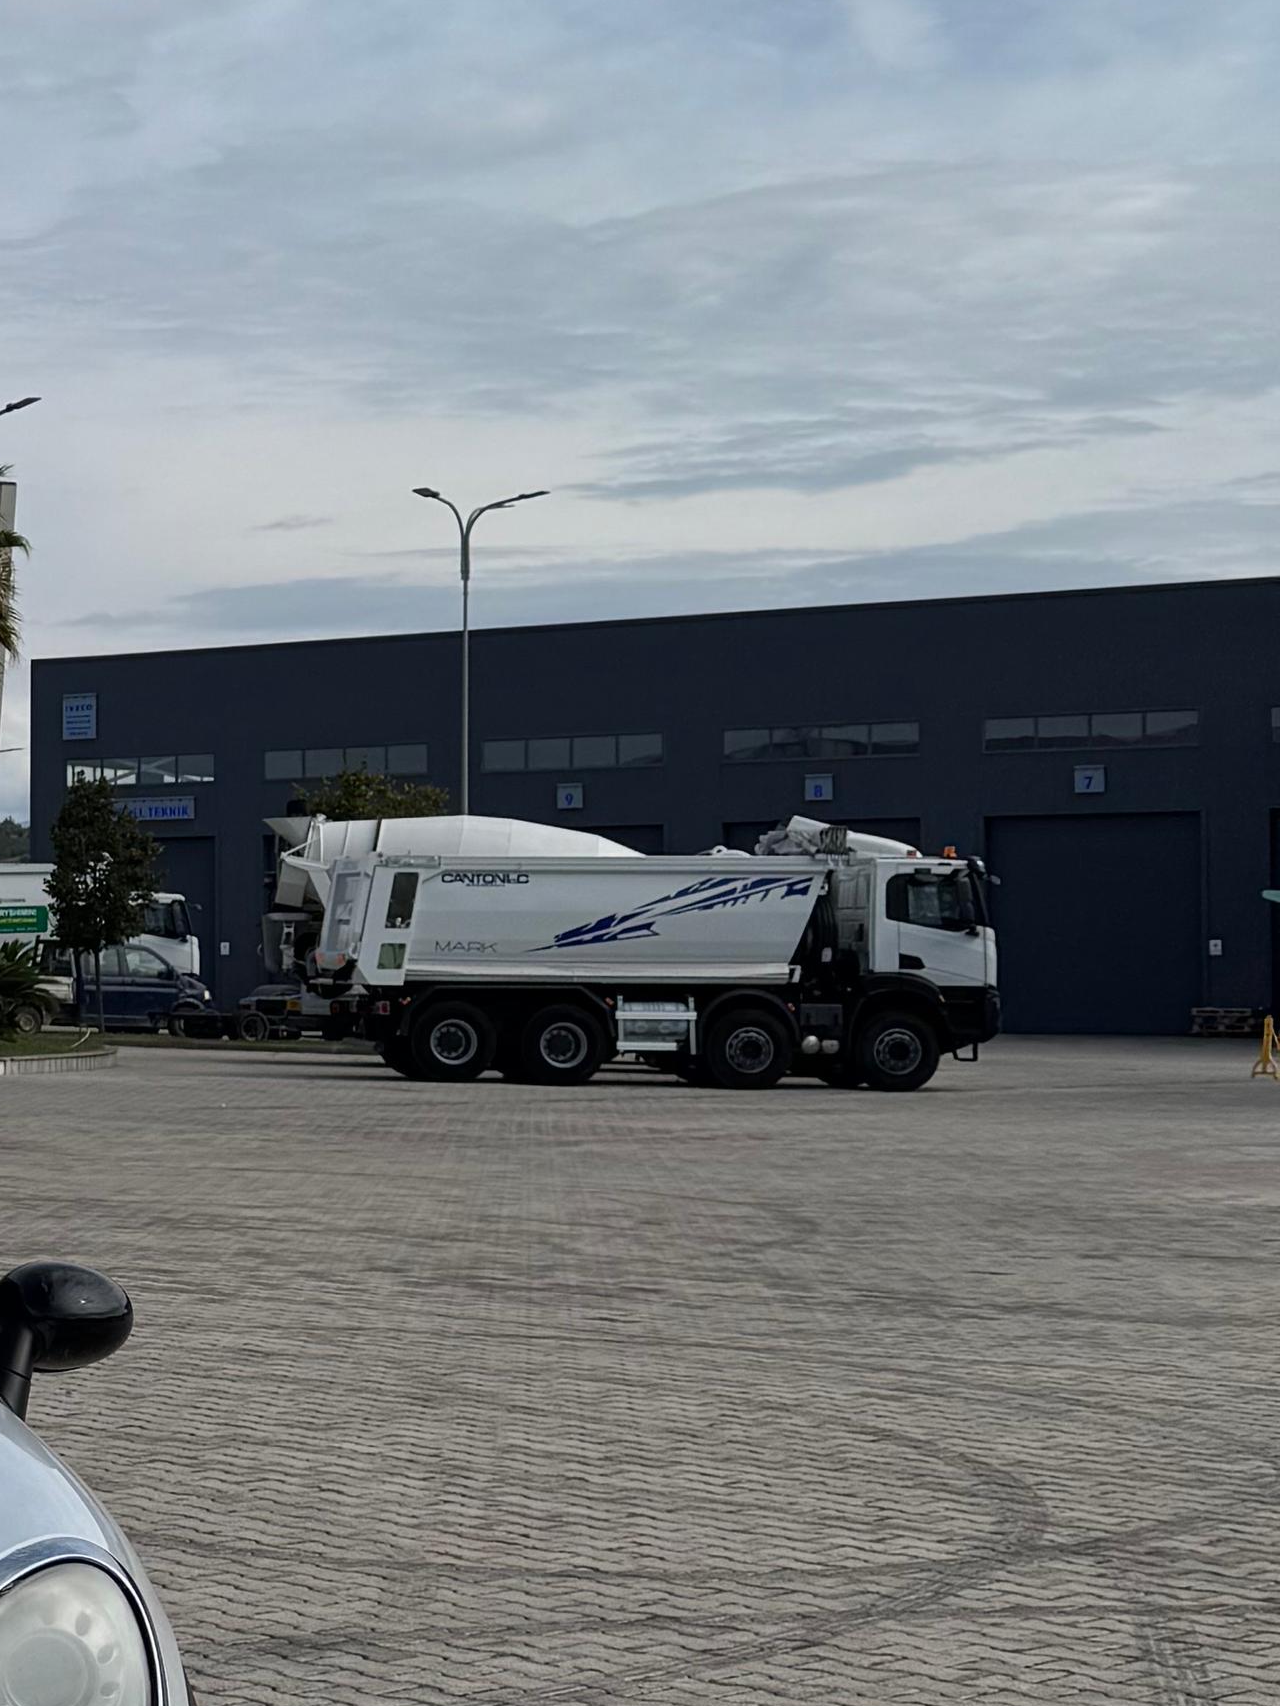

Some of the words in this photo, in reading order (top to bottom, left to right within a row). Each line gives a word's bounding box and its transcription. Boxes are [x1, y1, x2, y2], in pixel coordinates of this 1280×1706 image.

[1084, 776, 1093, 790] 7
[565, 792, 574, 806] 9
[435, 940, 498, 953] MARK
